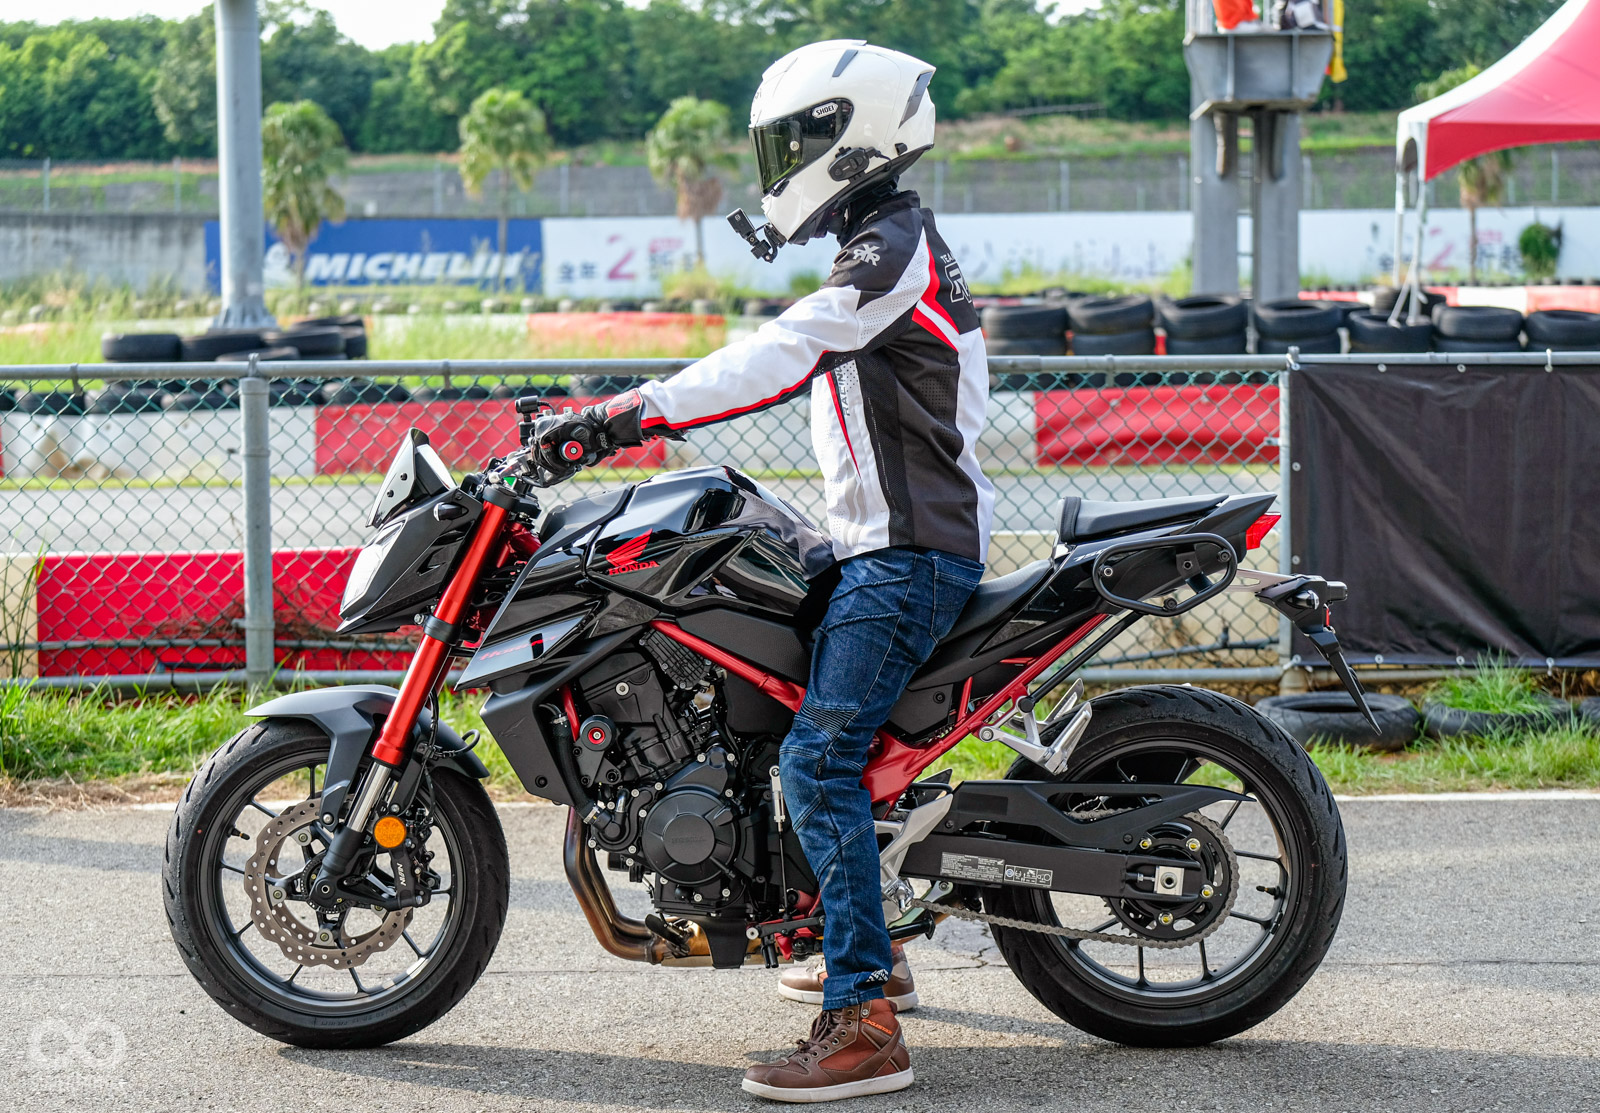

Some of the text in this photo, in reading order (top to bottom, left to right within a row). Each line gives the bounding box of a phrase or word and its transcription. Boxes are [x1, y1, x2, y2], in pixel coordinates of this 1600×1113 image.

[815, 105, 835, 116] SHOEI
[305, 252, 523, 281] MICHELIN
[607, 234, 636, 280] 2
[608, 561, 660, 576] HONDA
